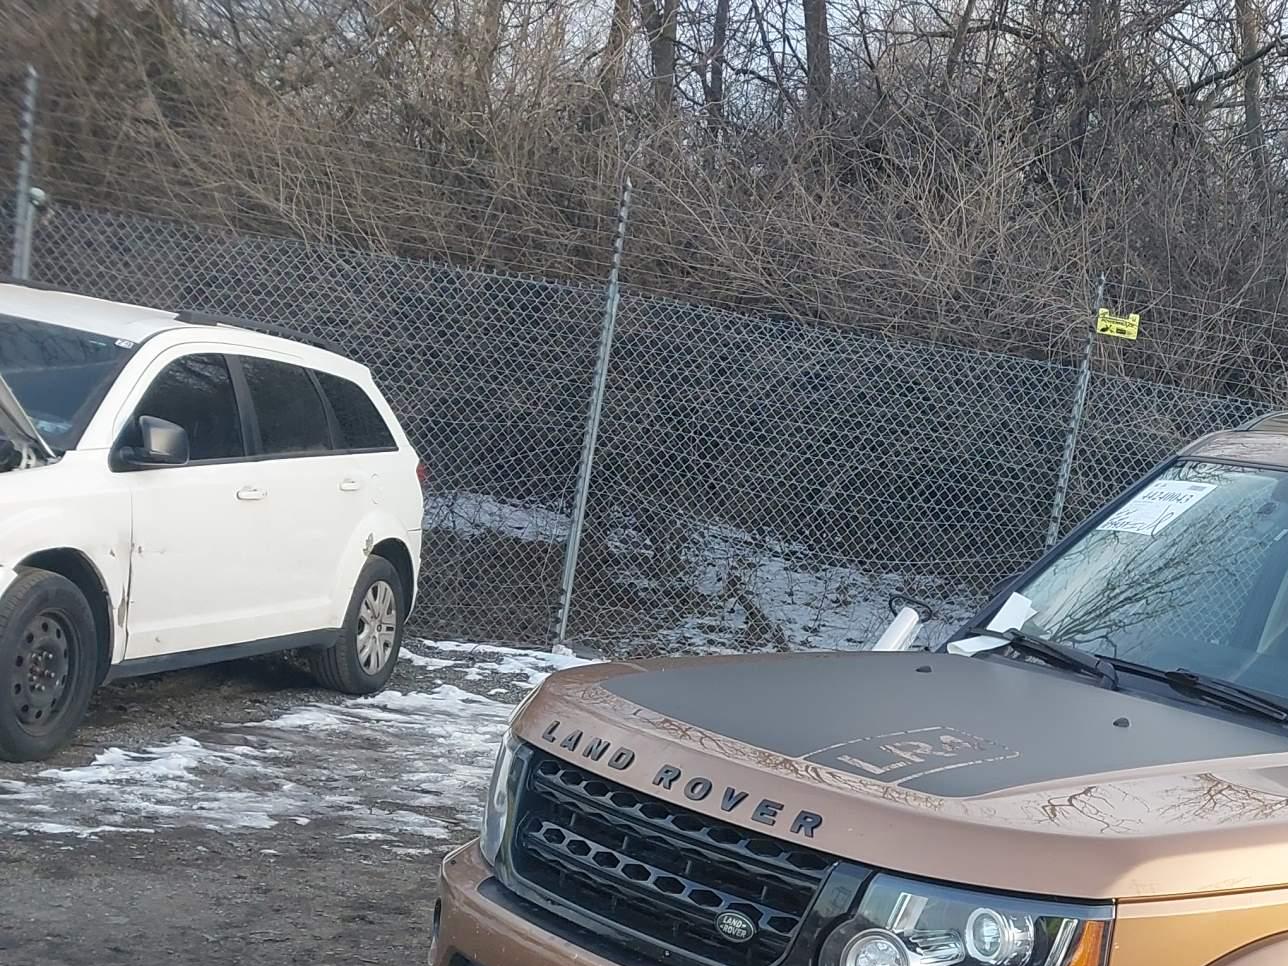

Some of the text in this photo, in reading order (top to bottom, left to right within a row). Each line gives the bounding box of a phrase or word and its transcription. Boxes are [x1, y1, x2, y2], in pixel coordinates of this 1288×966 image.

[542, 720, 823, 838] LAND ROVER
[722, 915, 743, 928] LAND
[722, 924, 747, 938] ROVER
